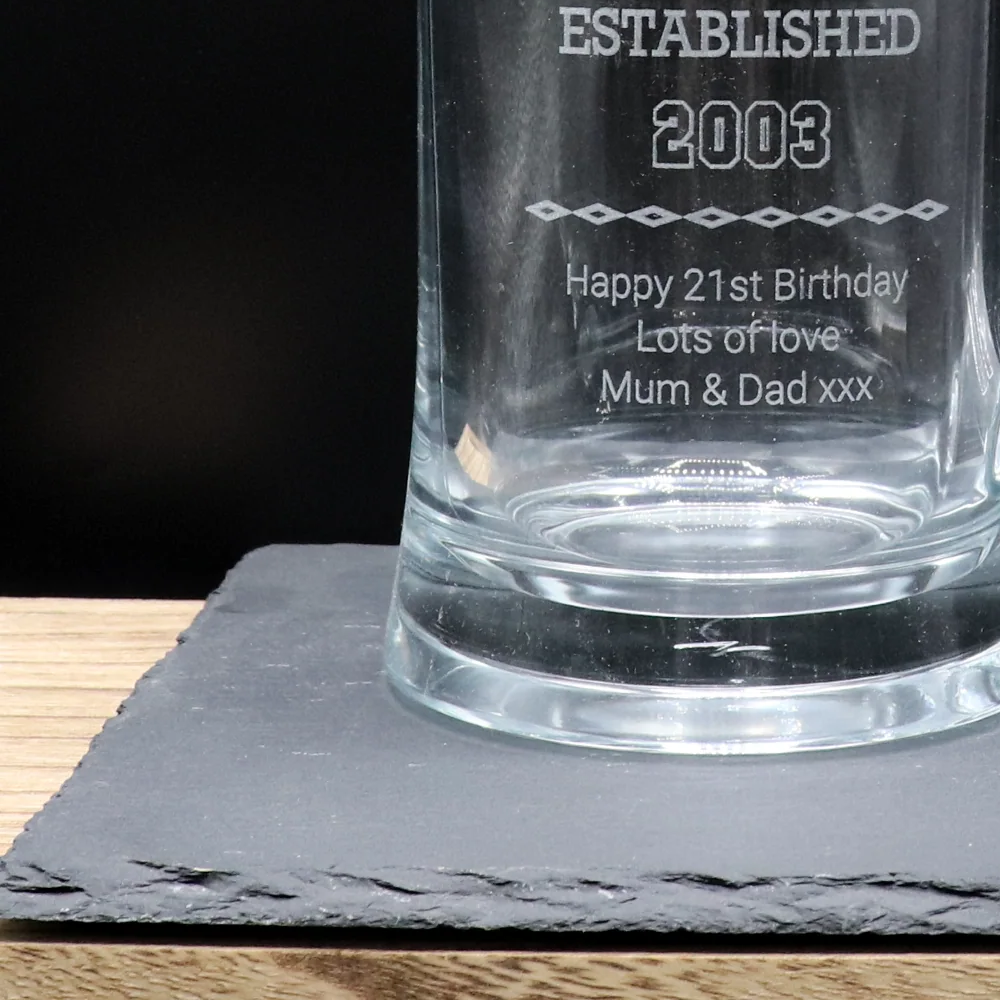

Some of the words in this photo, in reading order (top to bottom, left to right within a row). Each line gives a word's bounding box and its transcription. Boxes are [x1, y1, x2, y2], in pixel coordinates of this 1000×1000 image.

[558, 7, 921, 59] ESTABLISHED
[652, 99, 832, 170] 2003
[565, 263, 674, 309] Happy
[683, 267, 763, 302] 21st
[774, 262, 909, 304] Birthday
[637, 319, 713, 354] Lots
[724, 319, 764, 354] of
[771, 320, 841, 353] love
[602, 369, 690, 405] Mum
[702, 372, 728, 406] &
[739, 370, 807, 406] Dad
[818, 375, 874, 403] xxx
